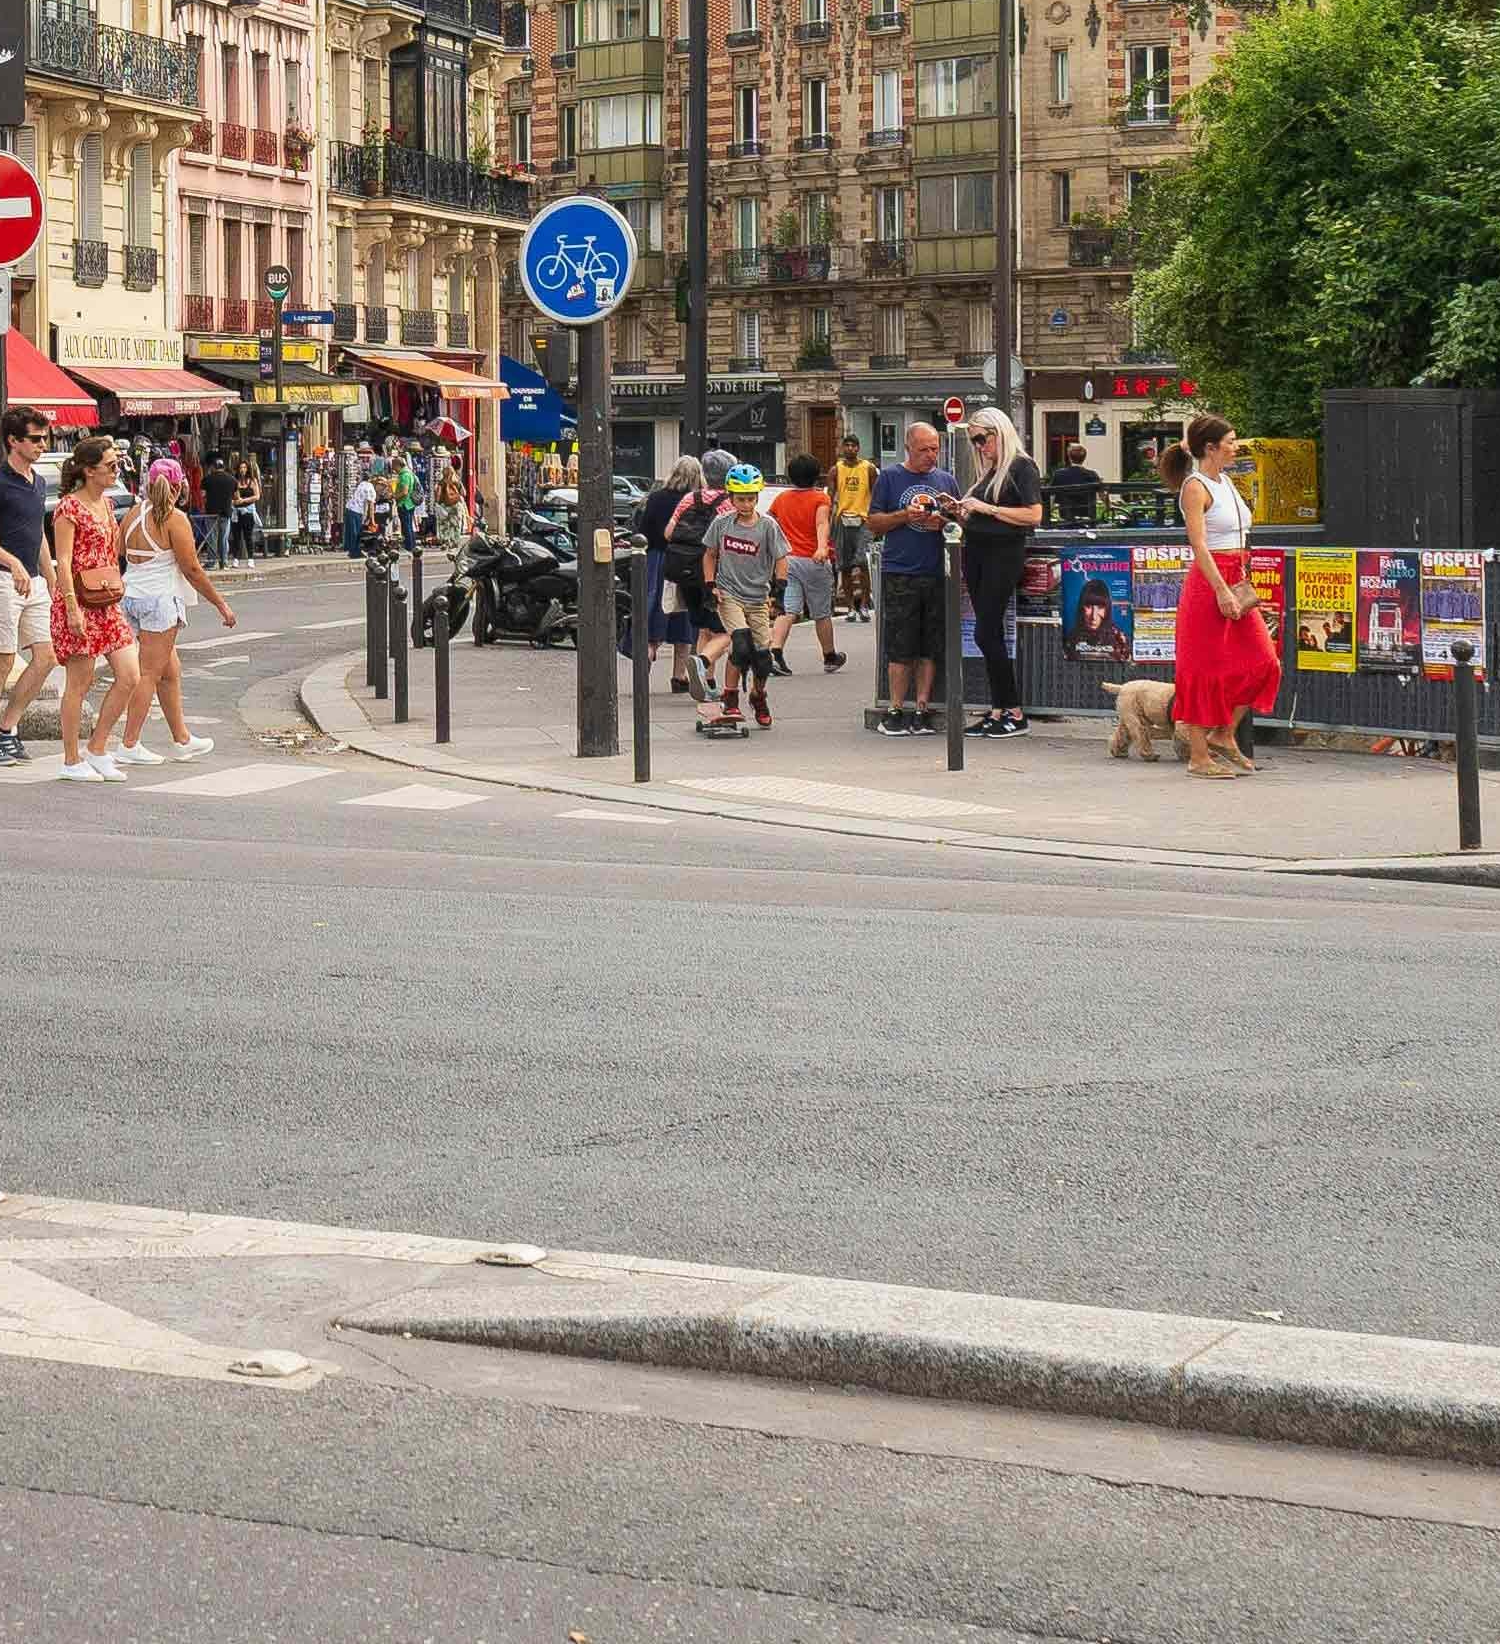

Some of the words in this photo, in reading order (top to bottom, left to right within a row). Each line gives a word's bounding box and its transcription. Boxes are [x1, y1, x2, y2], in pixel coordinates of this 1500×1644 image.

[268, 273, 288, 284] BUS
[65, 335, 80, 357] AUX
[82, 336, 118, 360] CADEAUX
[121, 338, 131, 360] DE
[134, 338, 157, 361] NOTRE
[160, 339, 180, 362] DAME
[1133, 547, 1195, 562] GOSPE
[1421, 552, 1481, 568] GOSPEL
[1380, 558, 1407, 570] RAVEL
[1298, 571, 1352, 585] POLYPHONIES
[1360, 578, 1398, 589] MOZART
[1304, 585, 1345, 599] CORSES
